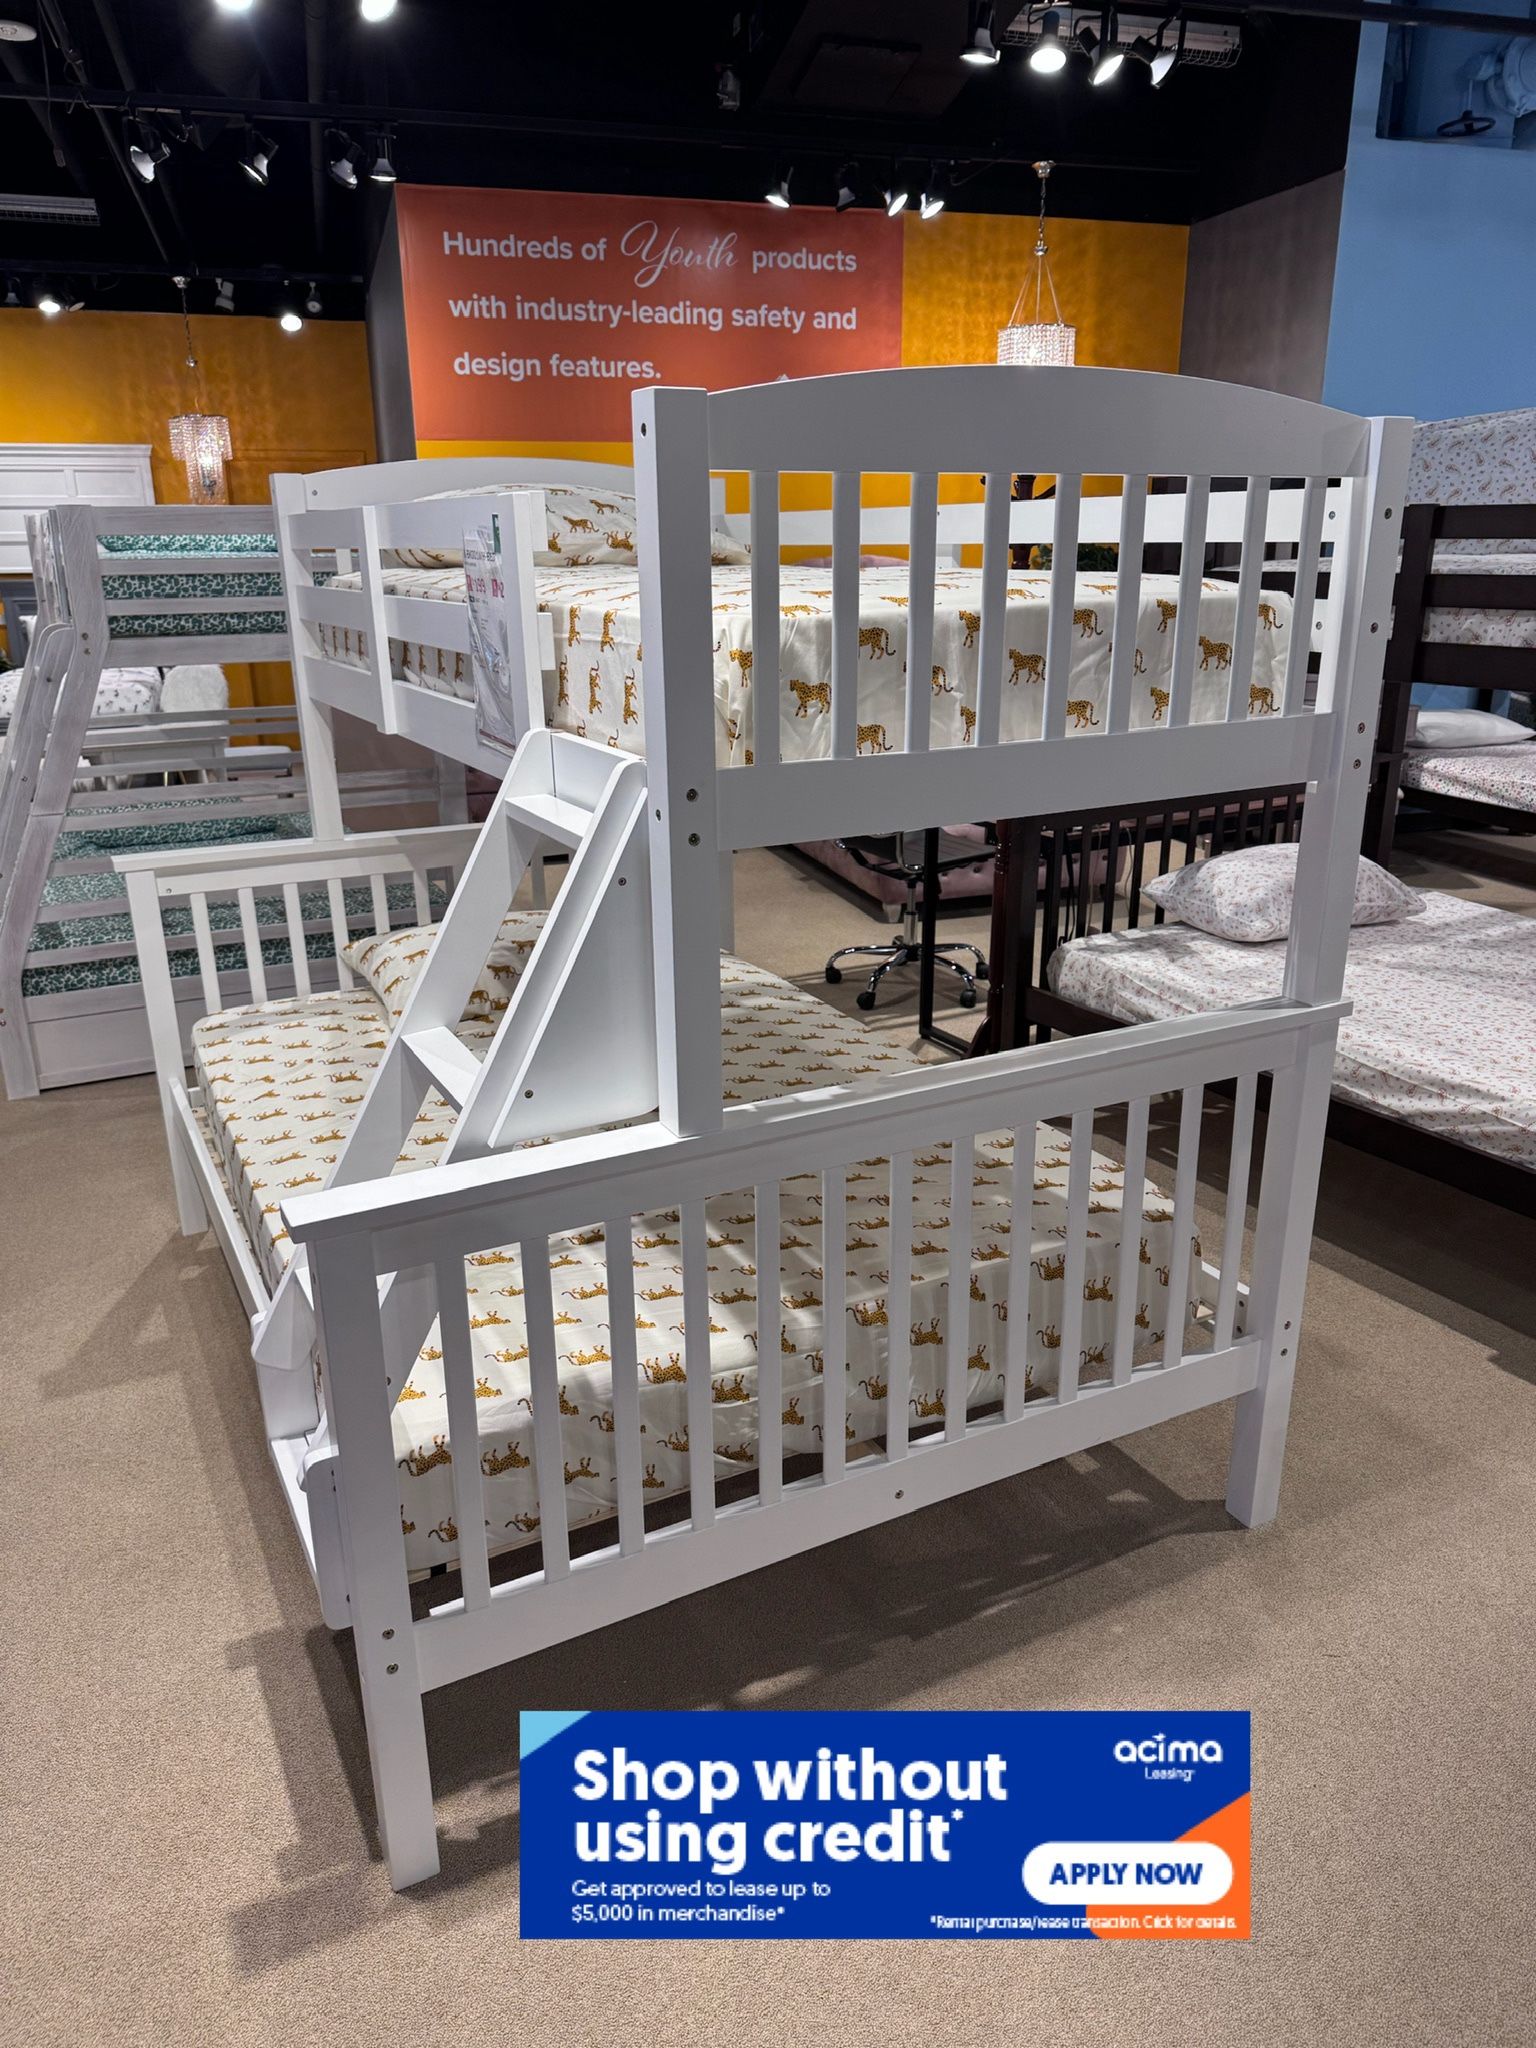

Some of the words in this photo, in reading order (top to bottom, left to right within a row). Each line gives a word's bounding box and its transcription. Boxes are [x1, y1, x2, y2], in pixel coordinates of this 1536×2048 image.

[443, 231, 573, 260] Hundreds
[581, 238, 607, 261] of
[620, 219, 740, 288] Youth
[752, 247, 858, 273] products
[448, 294, 507, 320] with
[515, 295, 724, 332] industry-leading
[731, 304, 806, 334] safety
[812, 307, 857, 331] and
[453, 351, 542, 382] design
[549, 352, 662, 379] features.
